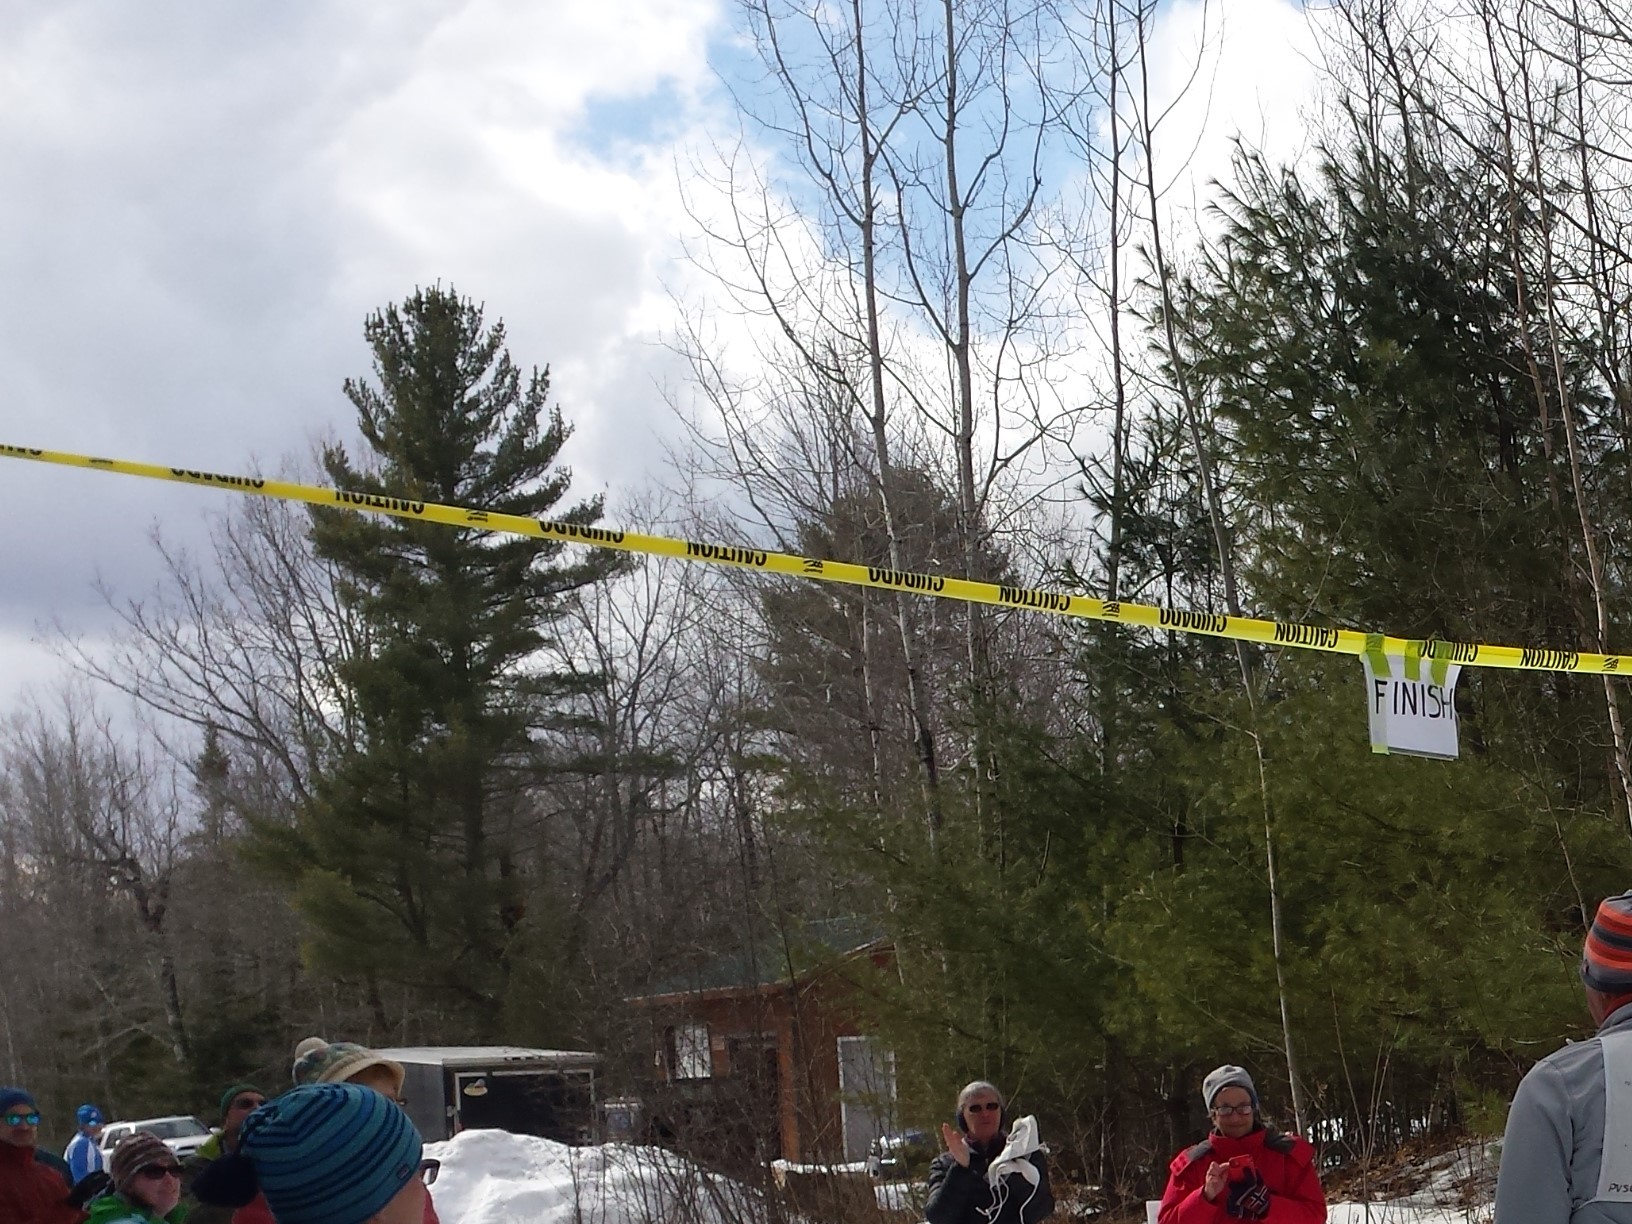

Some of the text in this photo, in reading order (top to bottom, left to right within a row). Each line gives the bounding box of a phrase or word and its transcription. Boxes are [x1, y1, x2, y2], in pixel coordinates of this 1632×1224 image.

[687, 542, 767, 567] CAUTION
[868, 566, 945, 592] CUIDADO
[999, 585, 1071, 611] CAUTION
[1159, 607, 1228, 633] CUIDADO
[1274, 622, 1339, 649] CAUTION
[1519, 648, 1579, 670] CAUTION
[1375, 679, 1453, 720] FINISH
